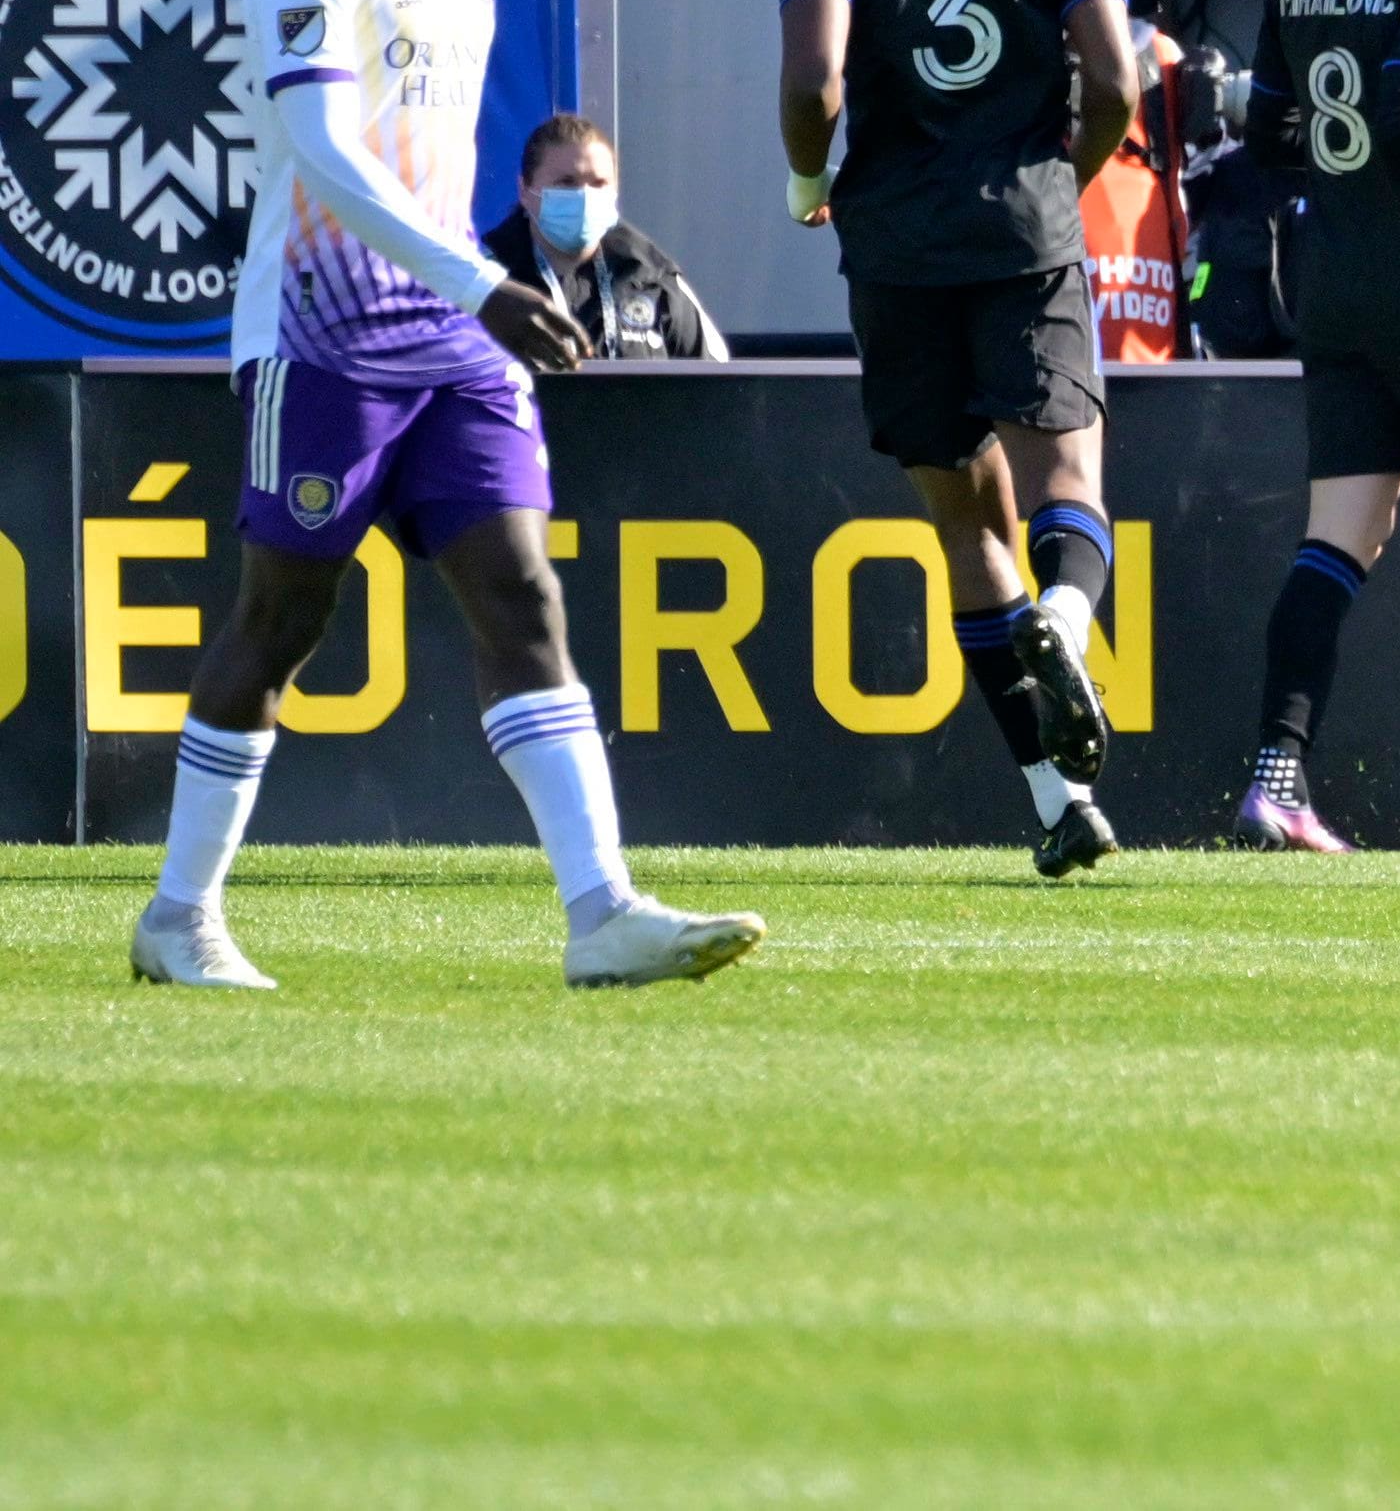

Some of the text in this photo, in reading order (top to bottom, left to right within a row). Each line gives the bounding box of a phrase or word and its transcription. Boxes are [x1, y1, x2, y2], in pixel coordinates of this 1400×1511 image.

[1307, 45, 1371, 176] 8
[1083, 255, 1175, 293] PHOTO
[1092, 291, 1171, 327] VIDEO
